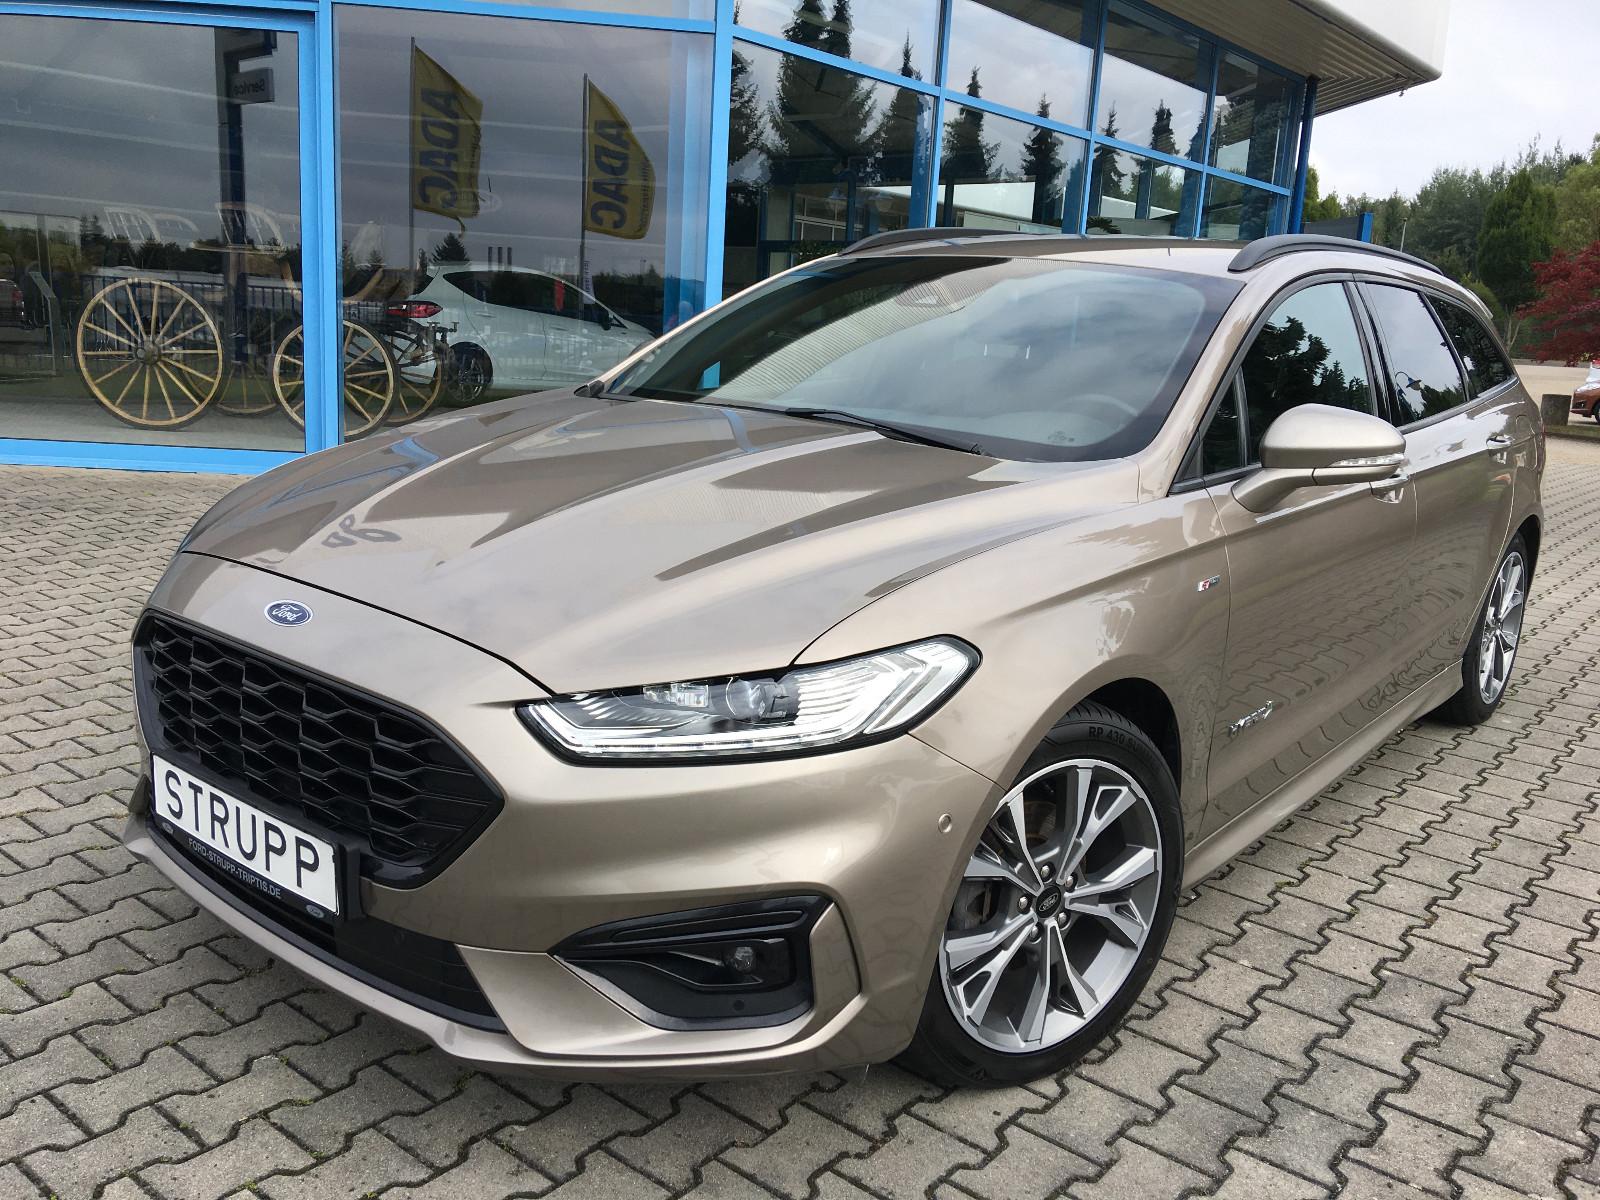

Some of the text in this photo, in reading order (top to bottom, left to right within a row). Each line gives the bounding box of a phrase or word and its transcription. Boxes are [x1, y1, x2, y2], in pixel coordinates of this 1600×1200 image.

[269, 603, 305, 623] Ford
[1088, 726, 1125, 744] RP 430
[165, 769, 320, 888] STRUPP
[188, 837, 282, 899] FORD-STRUPP-TRIPTIS.DE
